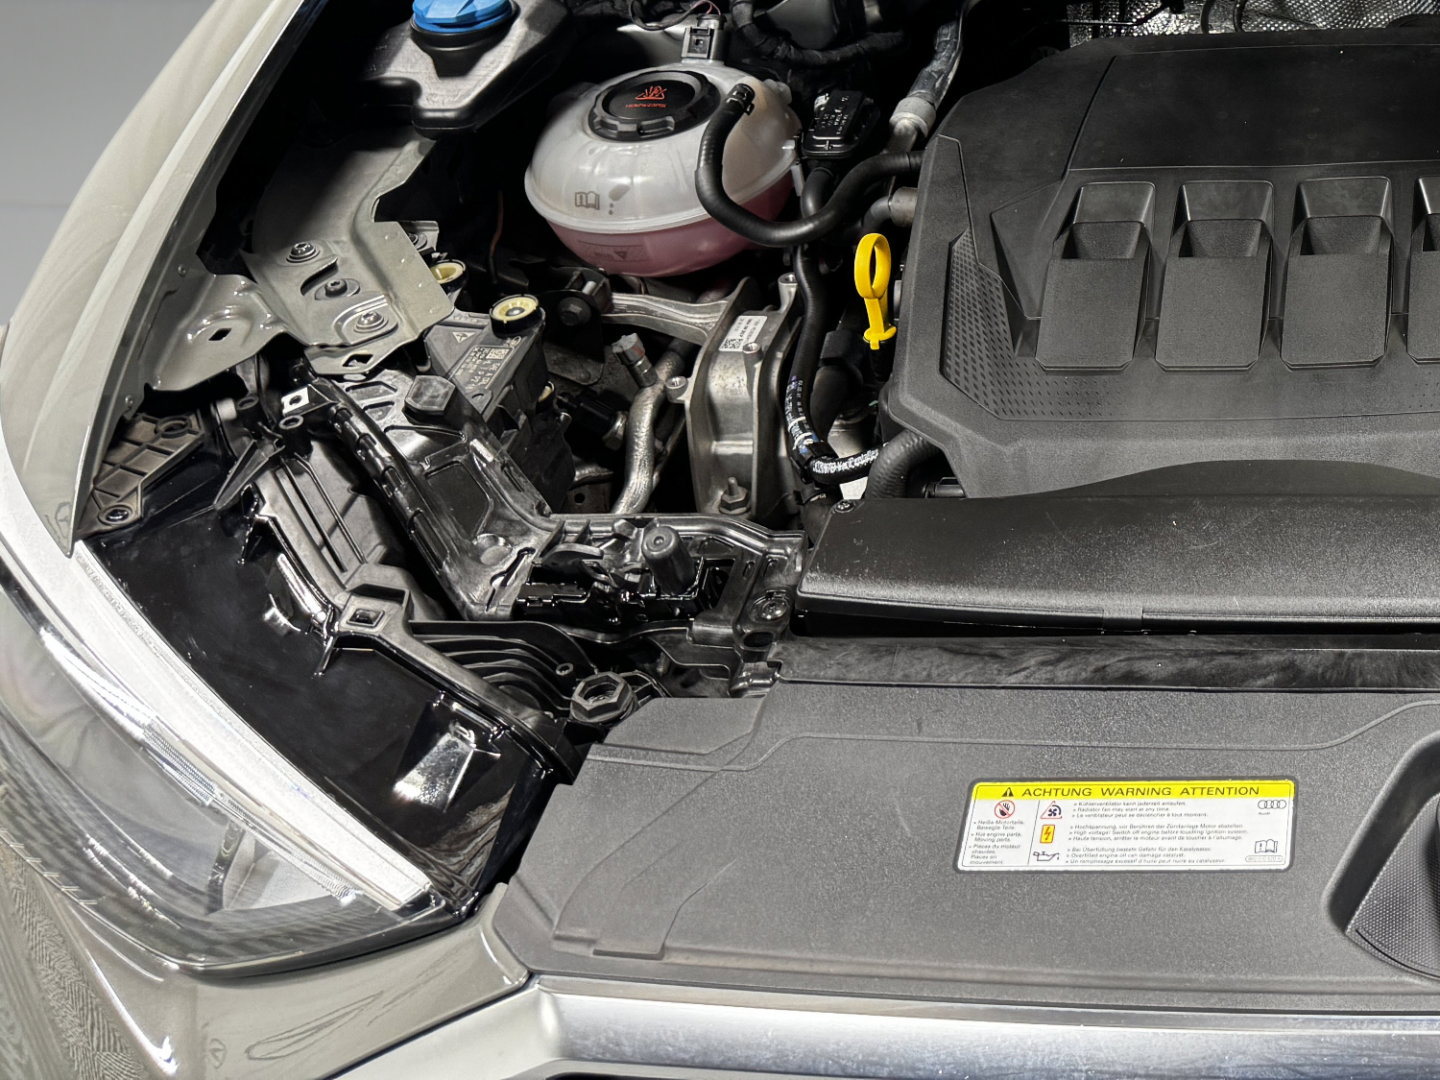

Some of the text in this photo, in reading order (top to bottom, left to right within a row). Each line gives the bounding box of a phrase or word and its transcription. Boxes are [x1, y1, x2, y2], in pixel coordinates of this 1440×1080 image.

[1022, 786, 1260, 797] ACHTUNG WARNING ATTENTION
